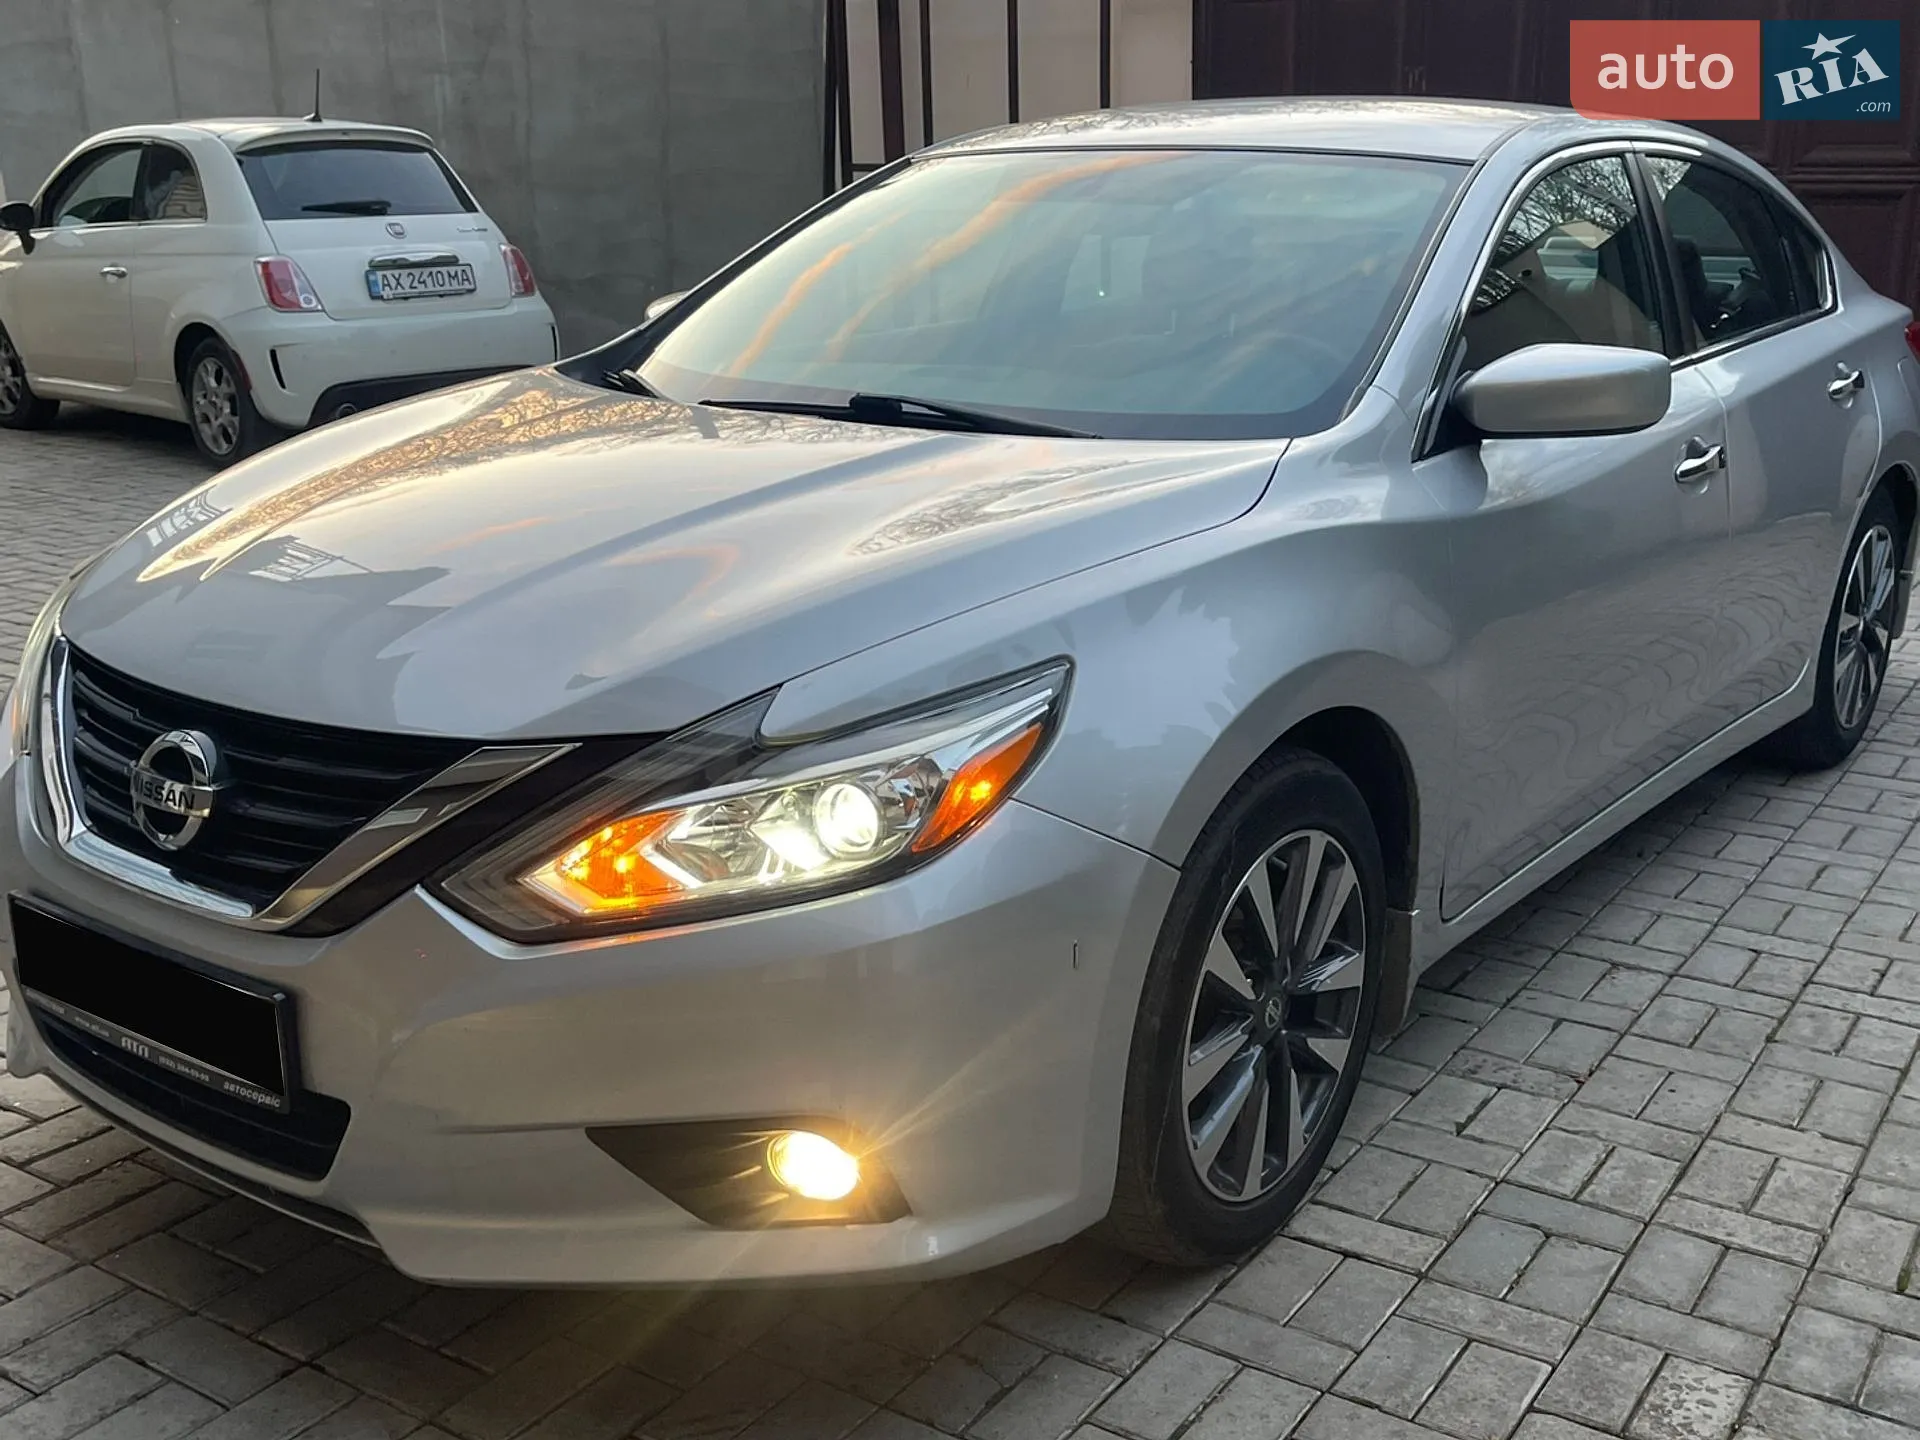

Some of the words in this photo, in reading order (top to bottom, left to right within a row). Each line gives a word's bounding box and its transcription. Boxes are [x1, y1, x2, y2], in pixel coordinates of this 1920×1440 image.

[381, 273, 406, 291] AX
[407, 270, 446, 291] 2410
[446, 269, 473, 287] MA
[134, 774, 196, 810] NISSAN
